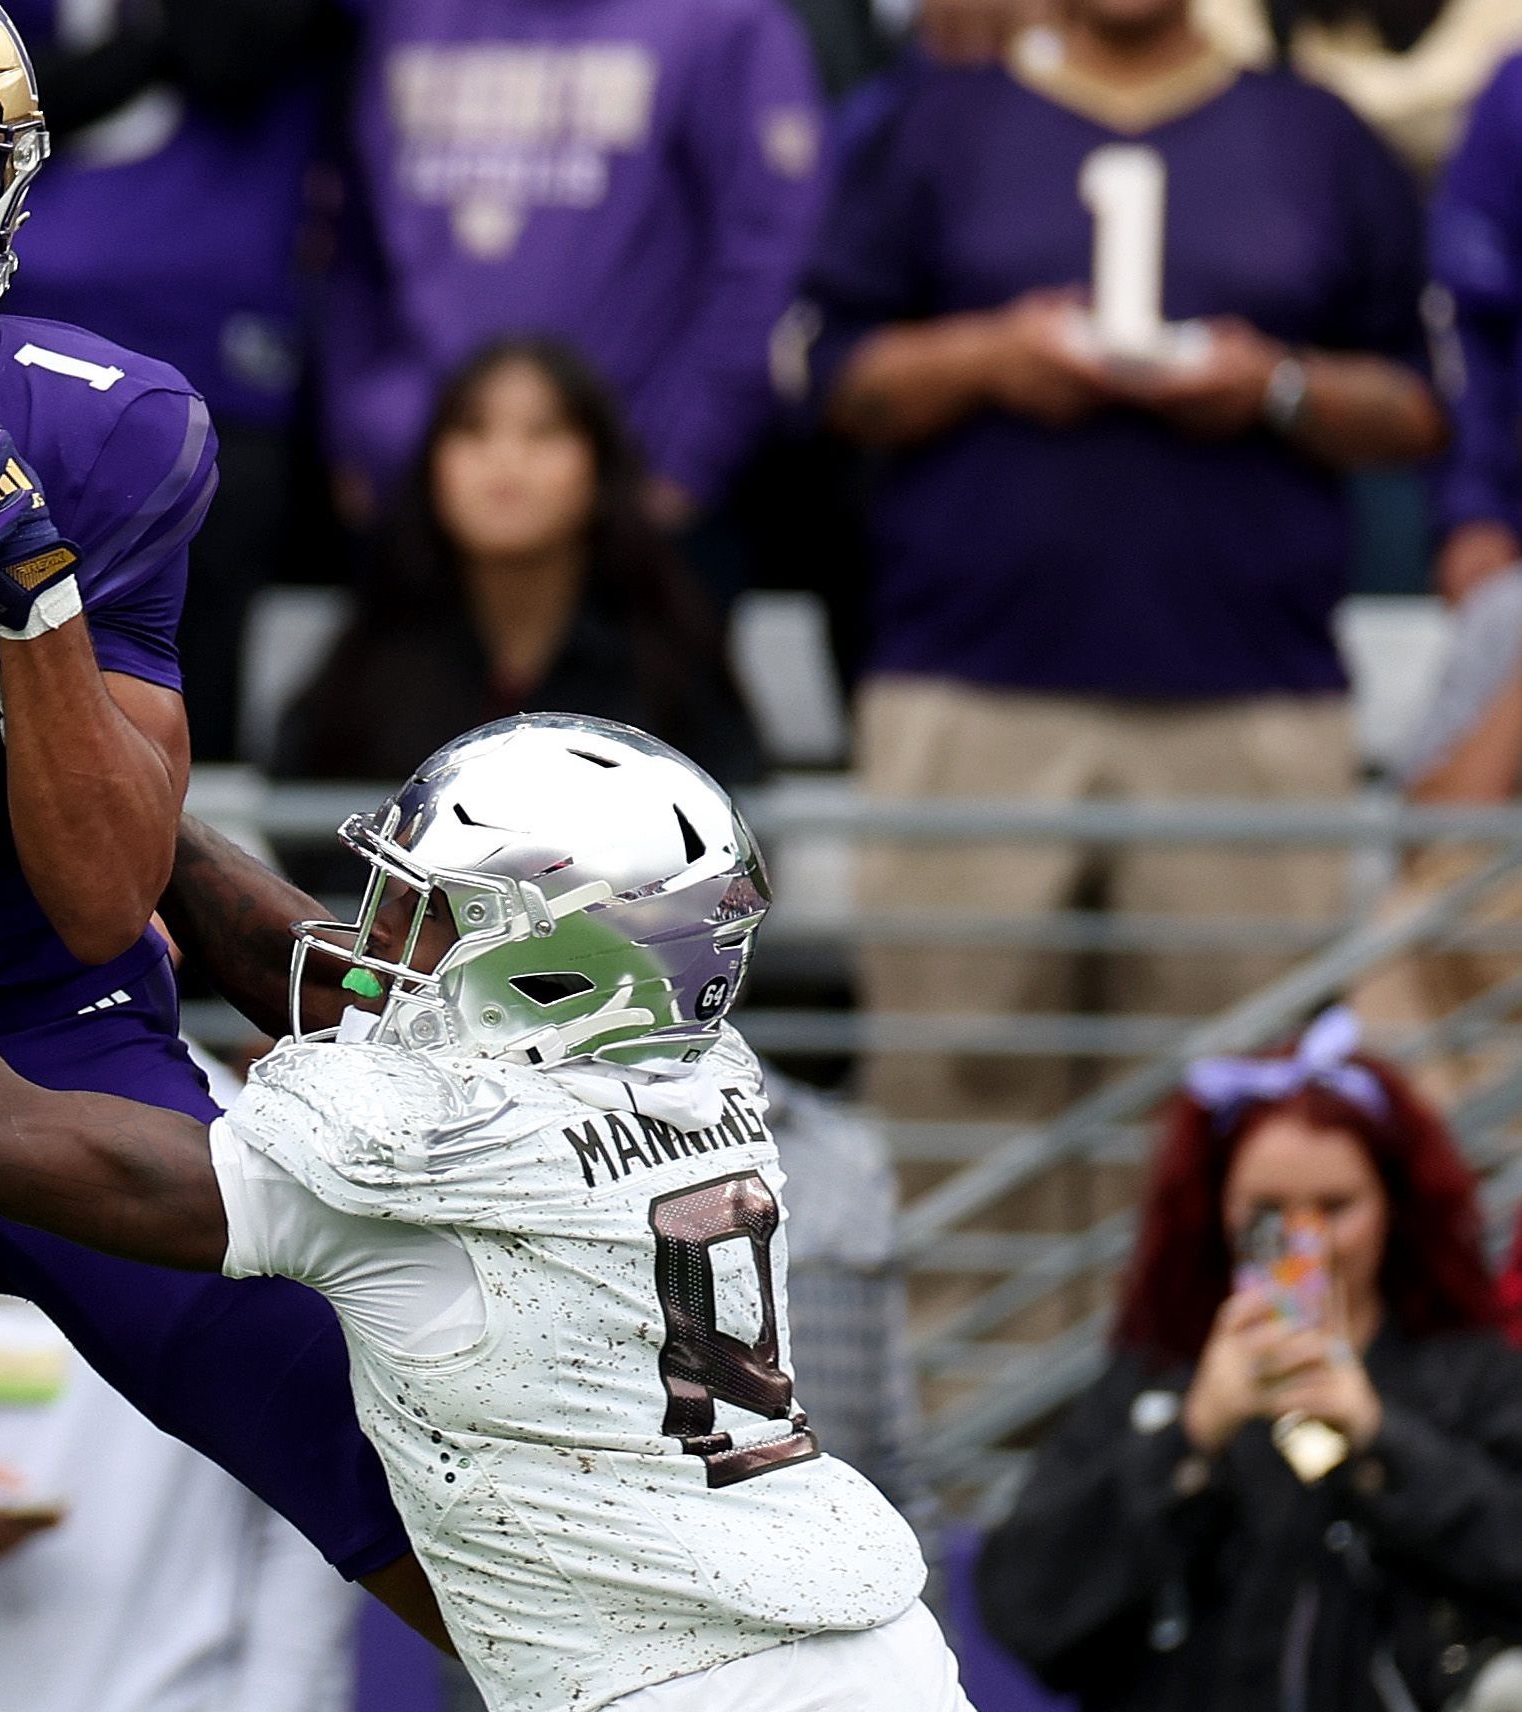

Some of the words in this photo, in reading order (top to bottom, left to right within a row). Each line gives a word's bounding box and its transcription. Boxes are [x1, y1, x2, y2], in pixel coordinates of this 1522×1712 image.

[1066, 144, 1213, 368] 1
[14, 343, 126, 391] 1
[701, 983, 727, 1007] 64
